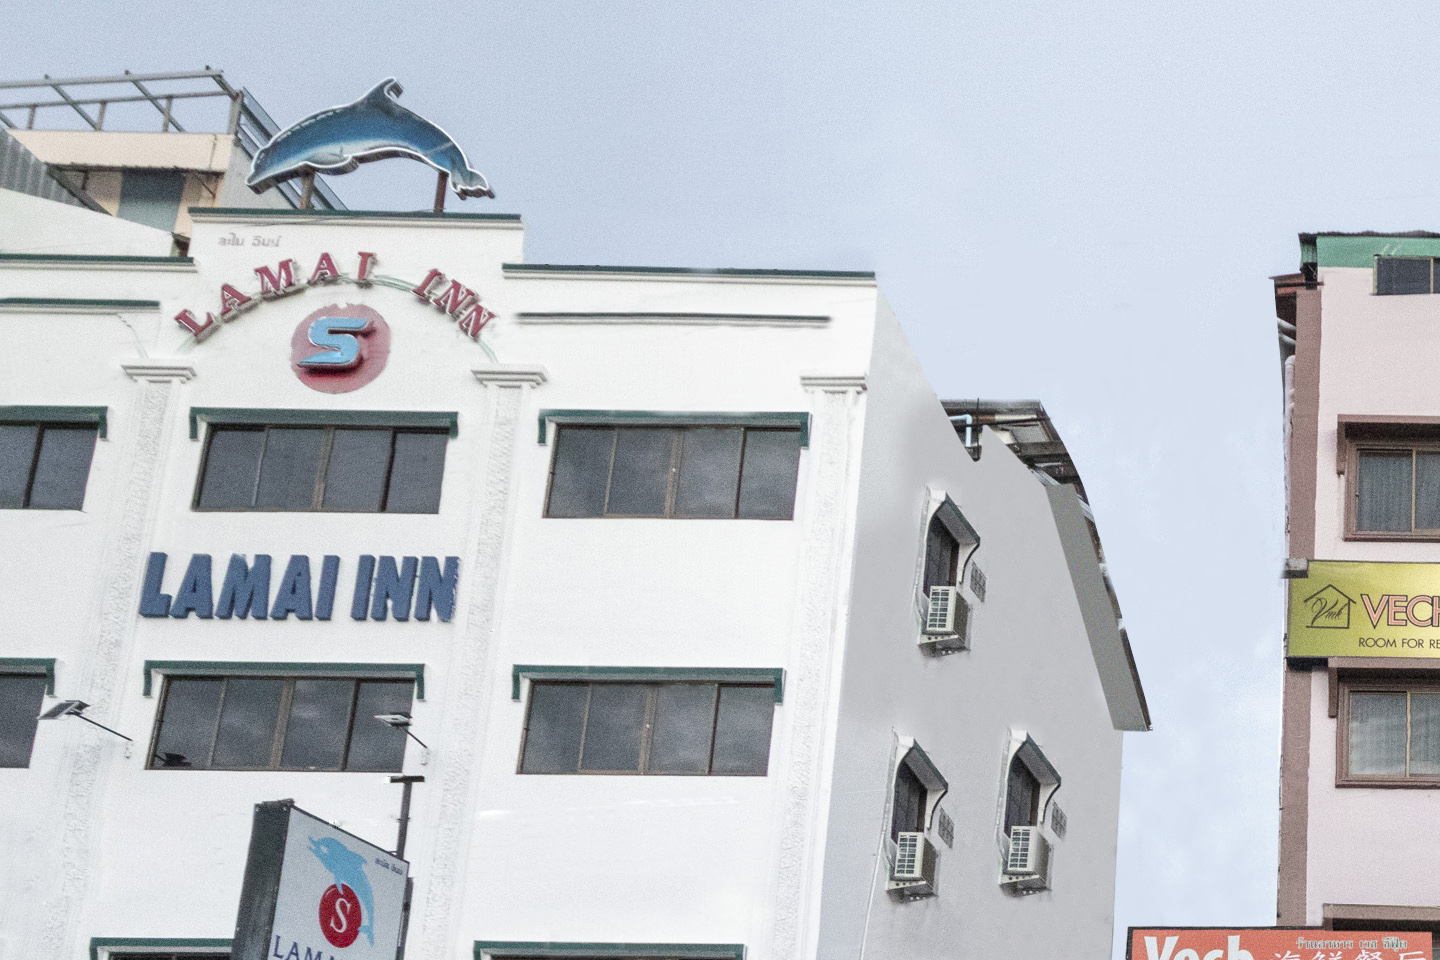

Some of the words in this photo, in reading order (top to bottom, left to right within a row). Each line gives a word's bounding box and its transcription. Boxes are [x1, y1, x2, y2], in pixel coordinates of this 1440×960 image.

[174, 251, 380, 342] LAMAI
[411, 268, 499, 341] INN
[296, 316, 368, 368] S
[138, 551, 341, 621] LAMAI
[351, 554, 463, 622] INN
[1358, 637, 1397, 649] ROOM
[1401, 638, 1424, 649] FOR
